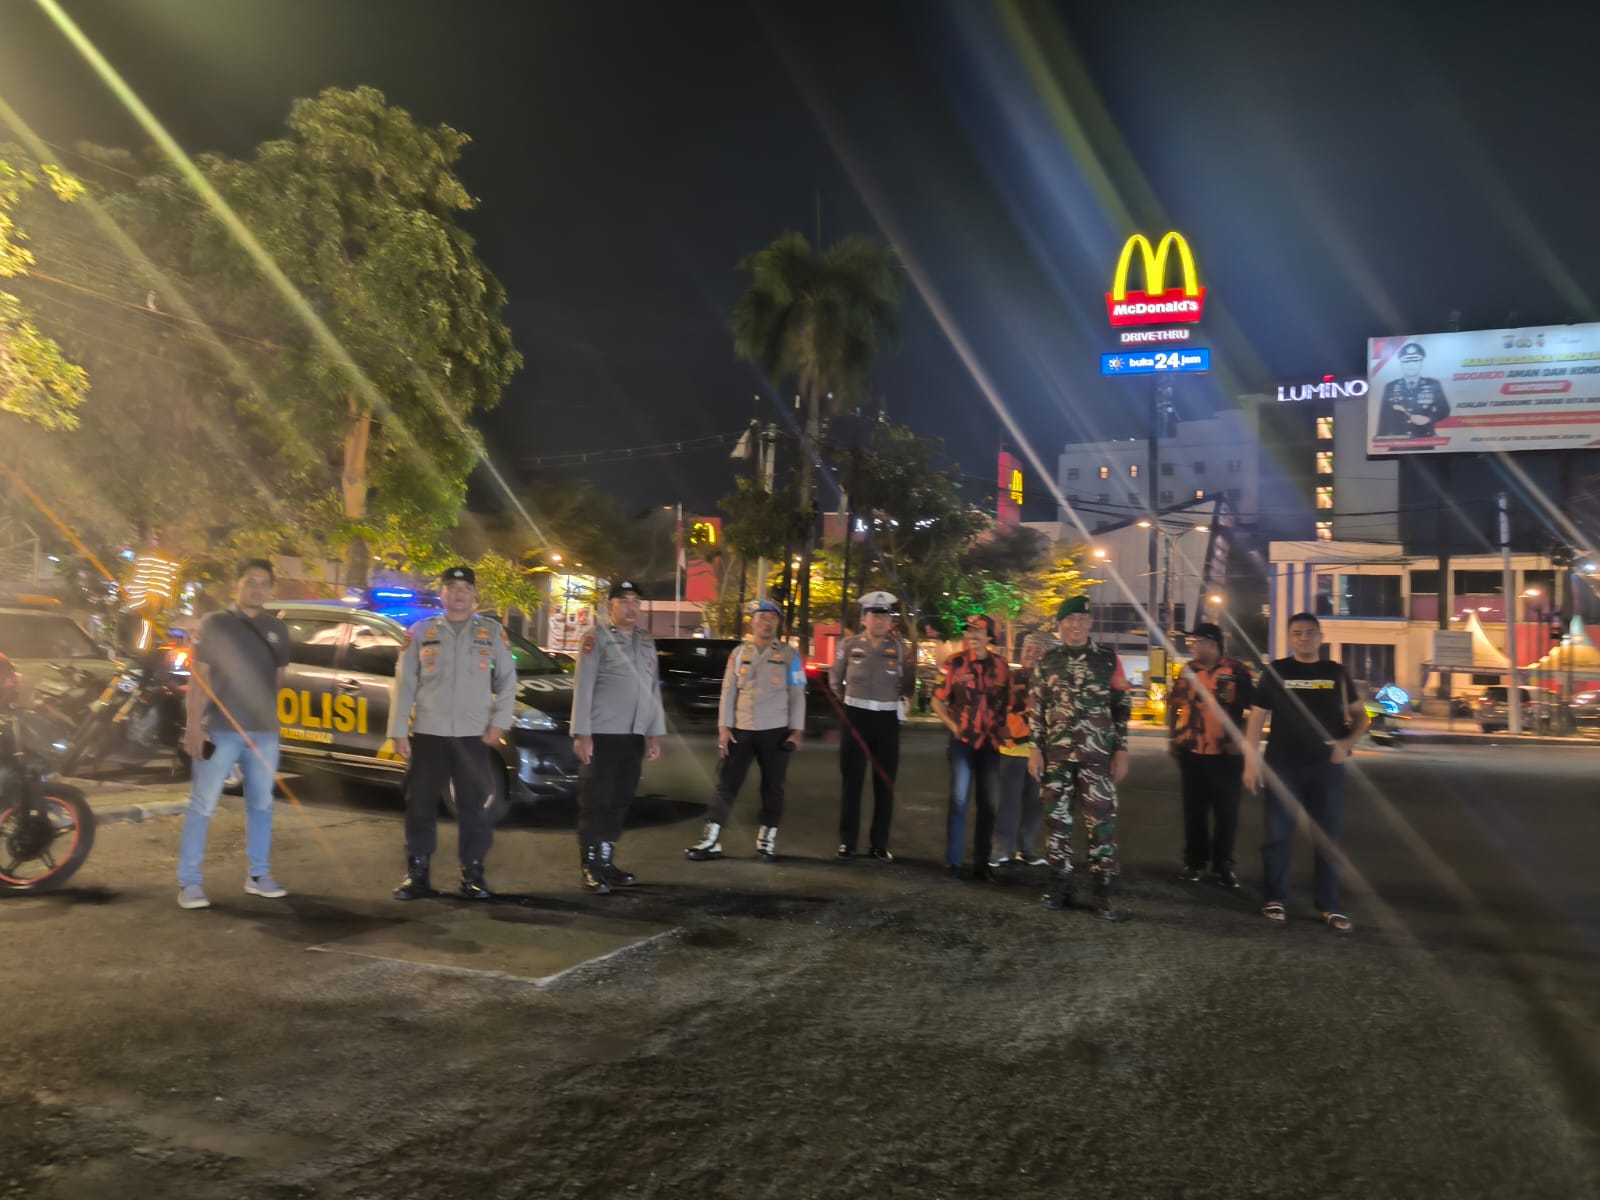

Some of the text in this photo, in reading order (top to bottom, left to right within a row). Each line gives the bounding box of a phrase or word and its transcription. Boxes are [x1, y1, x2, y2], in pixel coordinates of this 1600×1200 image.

[1113, 300, 1199, 316] McDonald's
[1154, 352, 1180, 369] 24
[1277, 379, 1368, 402] LUMINO
[277, 687, 368, 734] OLISI
